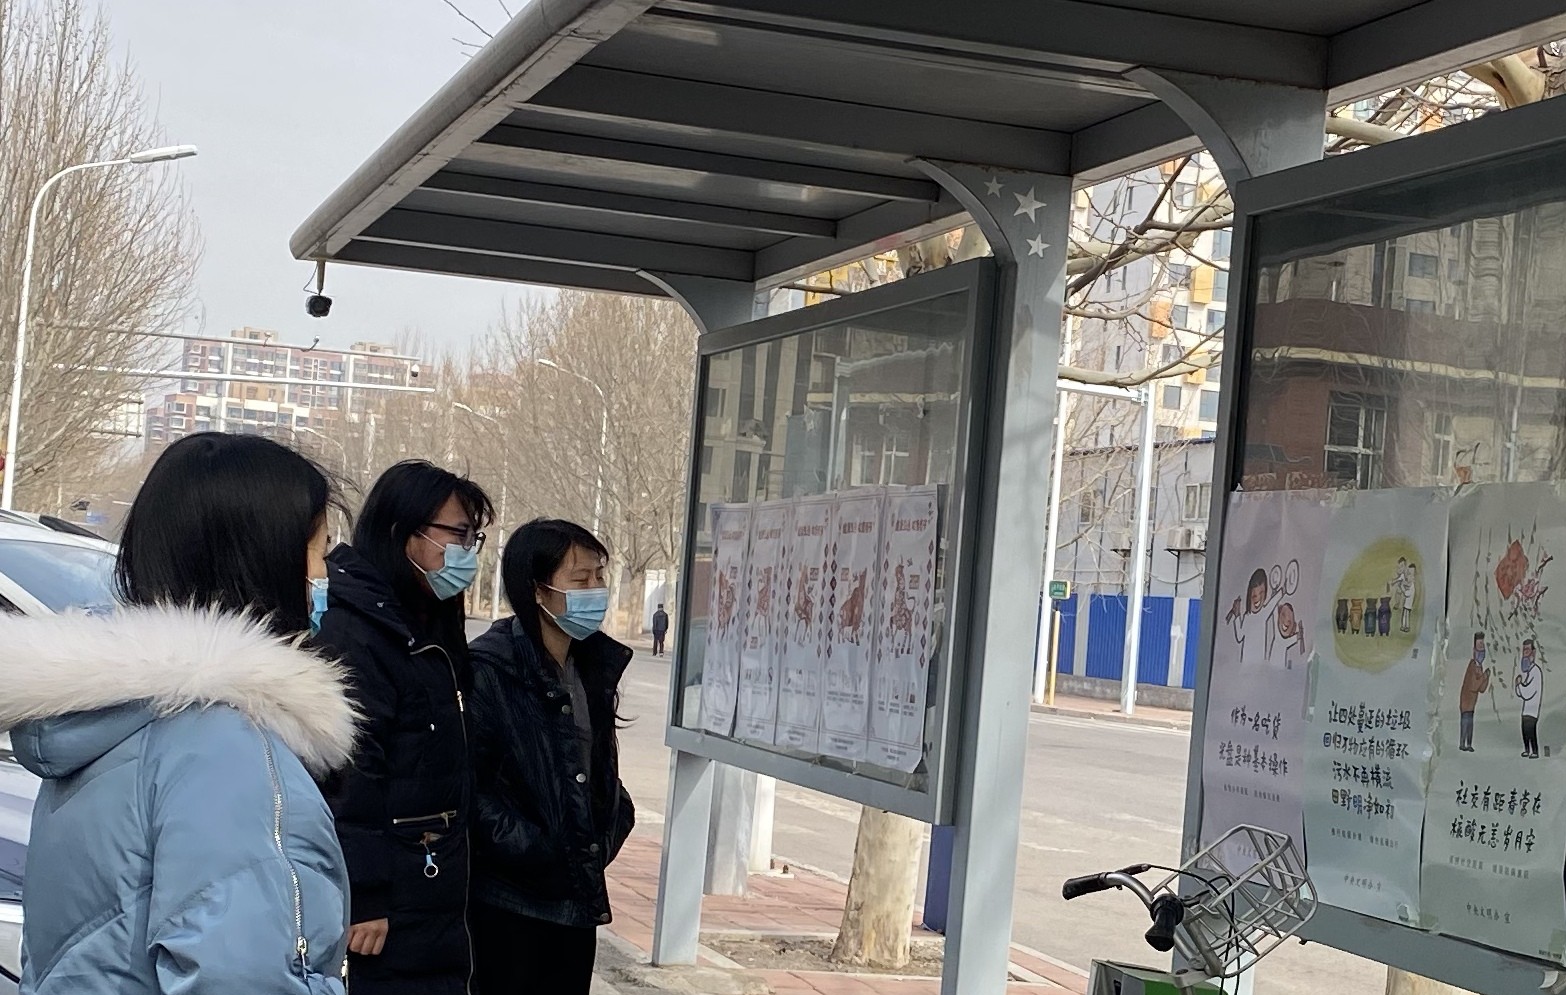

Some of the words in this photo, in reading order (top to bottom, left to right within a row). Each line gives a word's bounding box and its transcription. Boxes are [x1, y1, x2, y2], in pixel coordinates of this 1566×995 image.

[1456, 780, 1542, 818] 社交有距春常在
[1450, 815, 1536, 853] 核酸无恙岁月安
